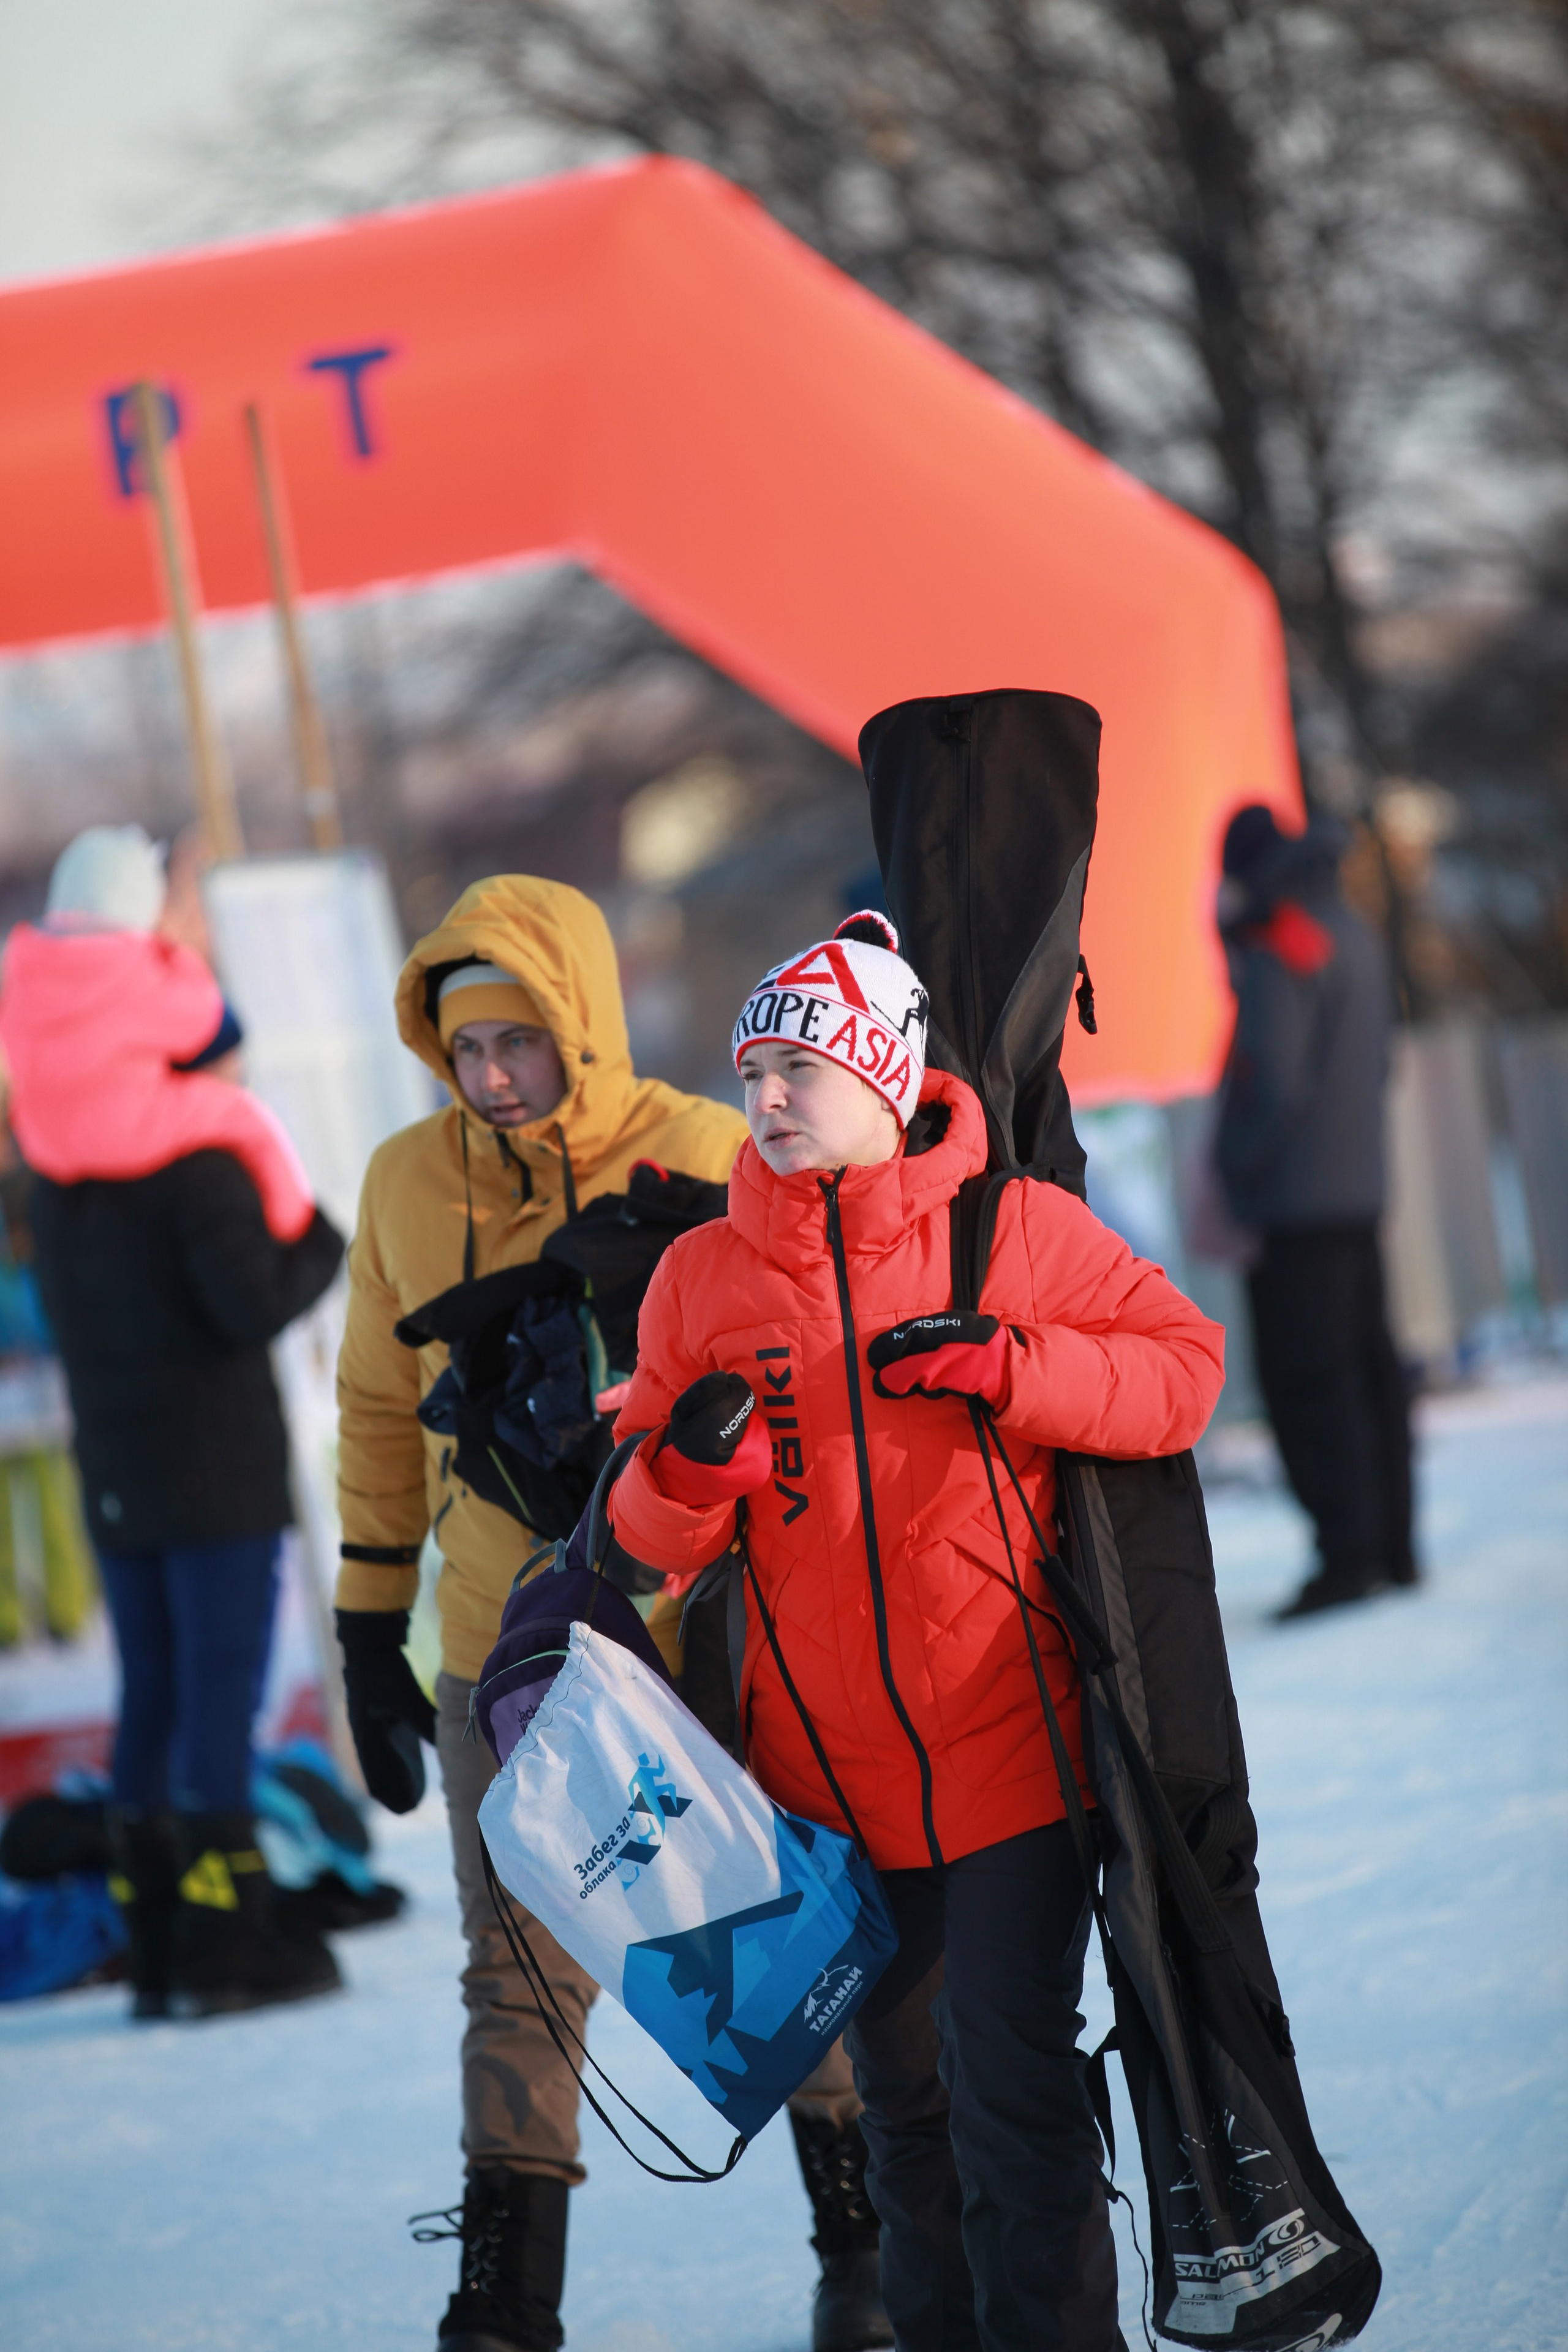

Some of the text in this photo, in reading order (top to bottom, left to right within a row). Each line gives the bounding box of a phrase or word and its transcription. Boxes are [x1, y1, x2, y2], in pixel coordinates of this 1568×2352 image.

[735, 992, 911, 1102] ROPE ASIA
[893, 1318, 961, 1340] NRDSKI
[719, 1390, 755, 1439] NORDSK
[573, 1816, 631, 1880] Забег за
[579, 1860, 617, 1899] облака
[809, 1966, 863, 2032] ТАГАНАЙ
[821, 1980, 864, 2036] национальный парк
[1175, 2241, 1265, 2278] SALMON
